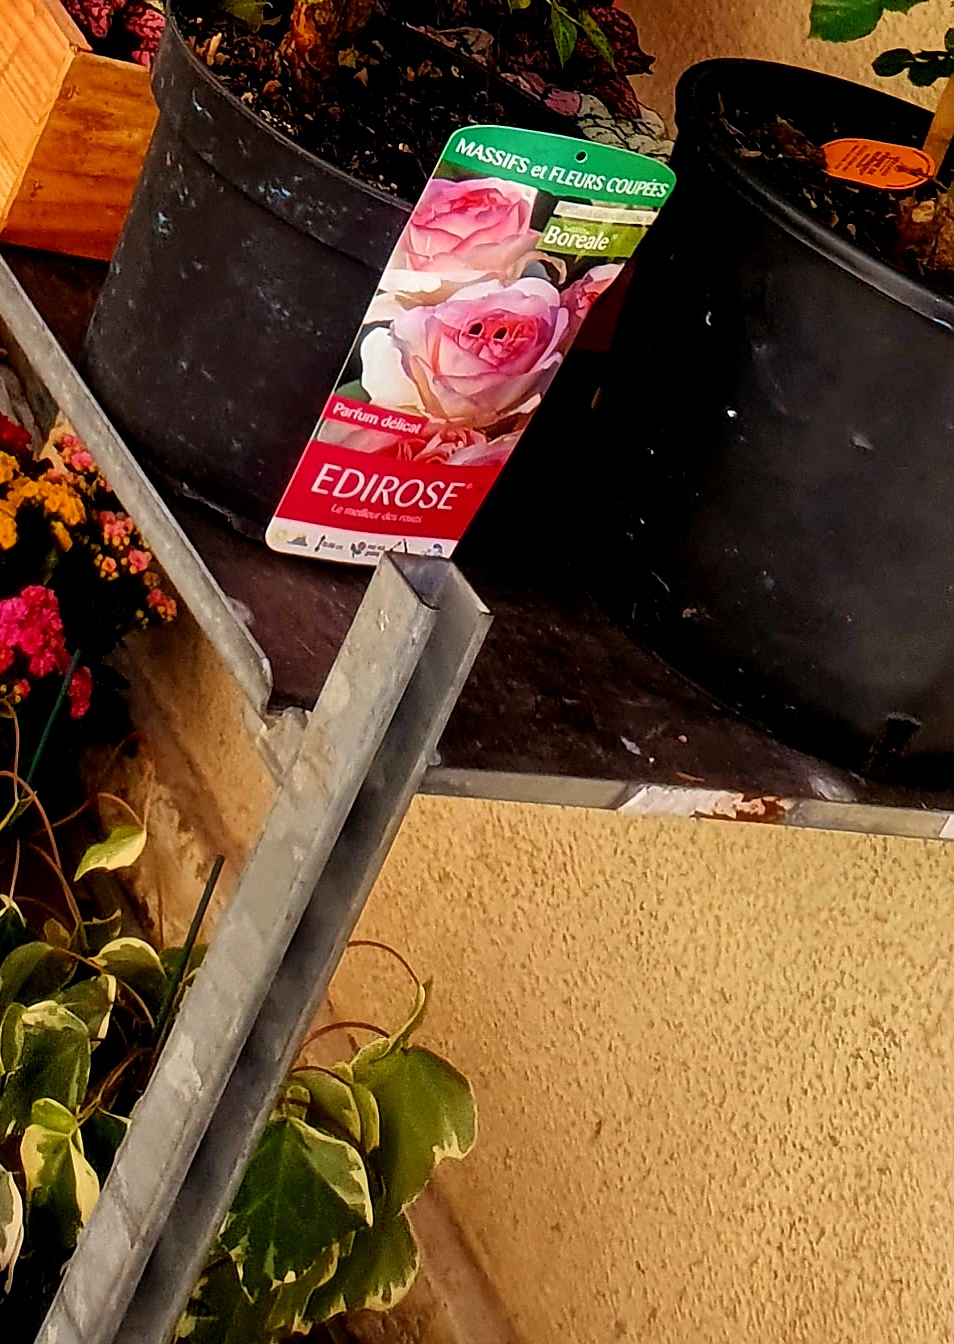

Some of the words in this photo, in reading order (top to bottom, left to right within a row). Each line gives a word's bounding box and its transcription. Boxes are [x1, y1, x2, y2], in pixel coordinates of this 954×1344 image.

[455, 137, 530, 174] MASSIFS
[530, 164, 546, 180] et
[548, 168, 606, 191] FLEURS
[605, 176, 669, 198] COUPÉES
[332, 401, 379, 425] Parfum
[380, 415, 423, 434] délicat
[310, 462, 466, 511] EDIROSE
